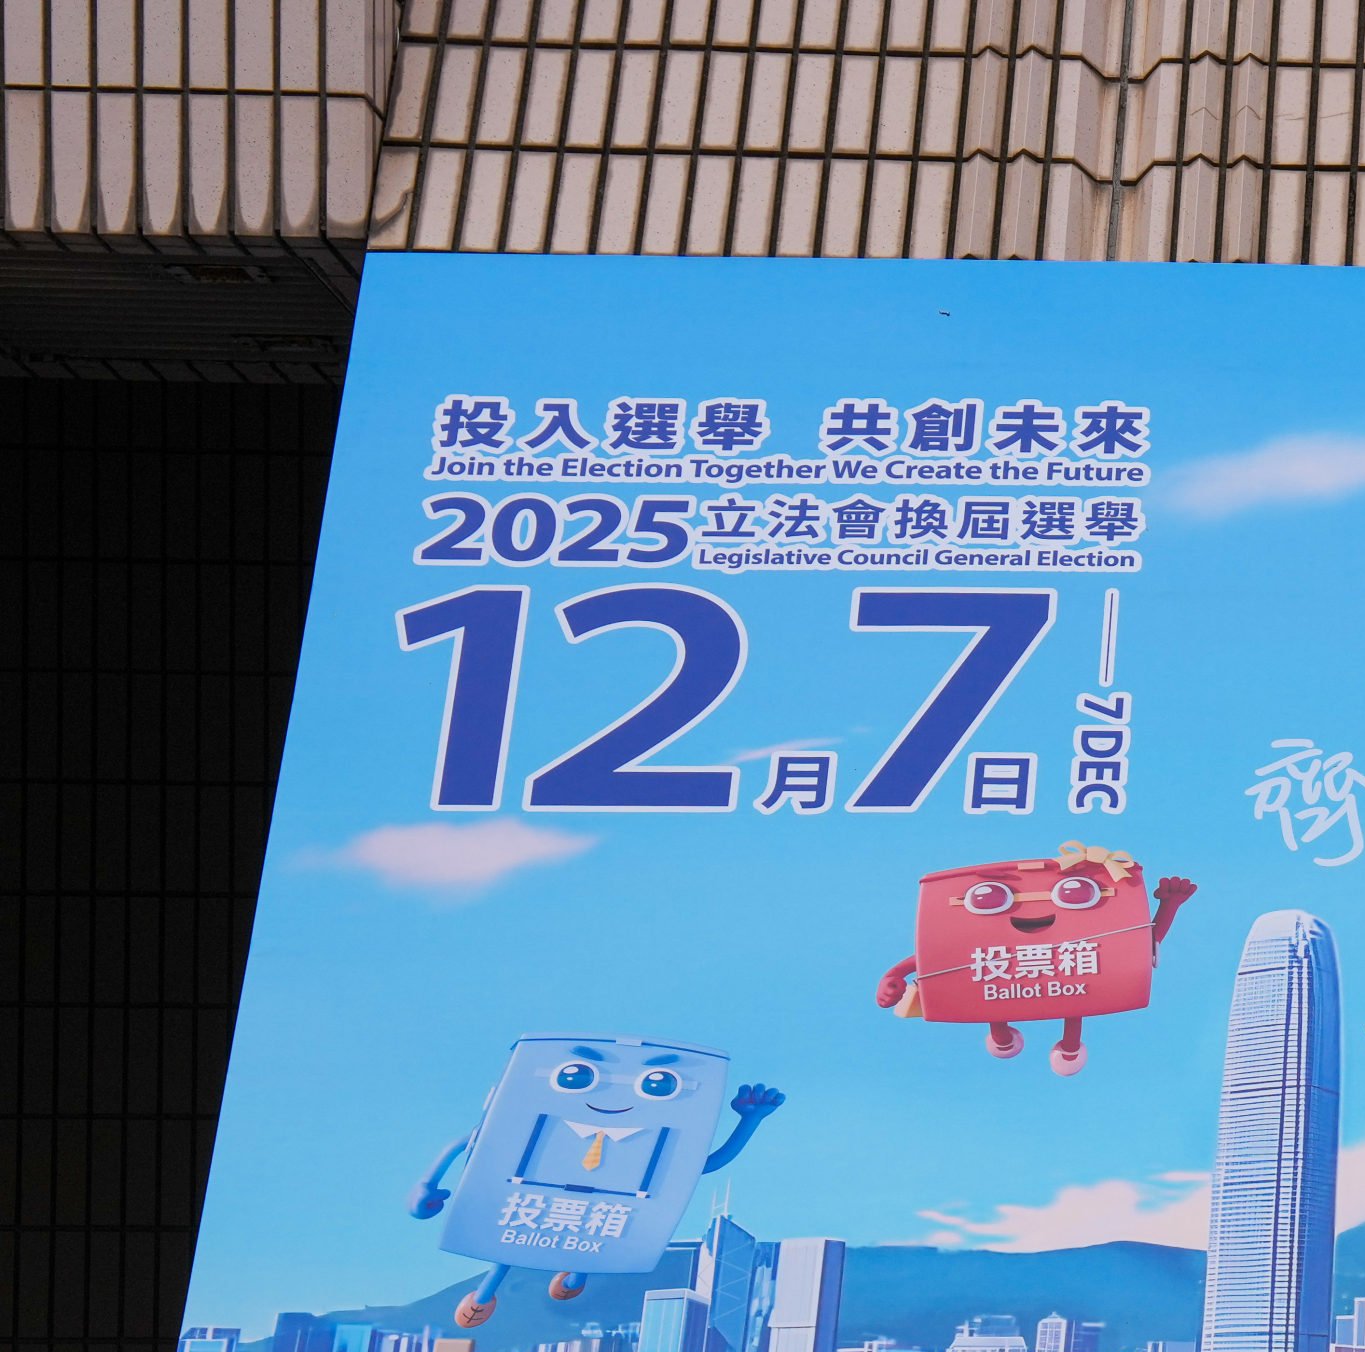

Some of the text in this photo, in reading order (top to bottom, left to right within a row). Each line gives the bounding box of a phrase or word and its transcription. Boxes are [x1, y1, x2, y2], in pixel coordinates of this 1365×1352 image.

[439, 399, 1143, 454] 投入選舉 共創未來
[431, 456, 1144, 484] Join the Election Together We Create the Future
[420, 497, 1138, 563] 2025 立法會換屆選舉
[699, 548, 1135, 569] Legislative Council General Election
[403, 588, 1051, 809] 12月7日
[970, 941, 1099, 982] 投票箱
[984, 981, 1087, 1001] Ballot Box
[497, 1193, 633, 1239] 投票箱
[500, 1229, 604, 1254] Ballot Box
